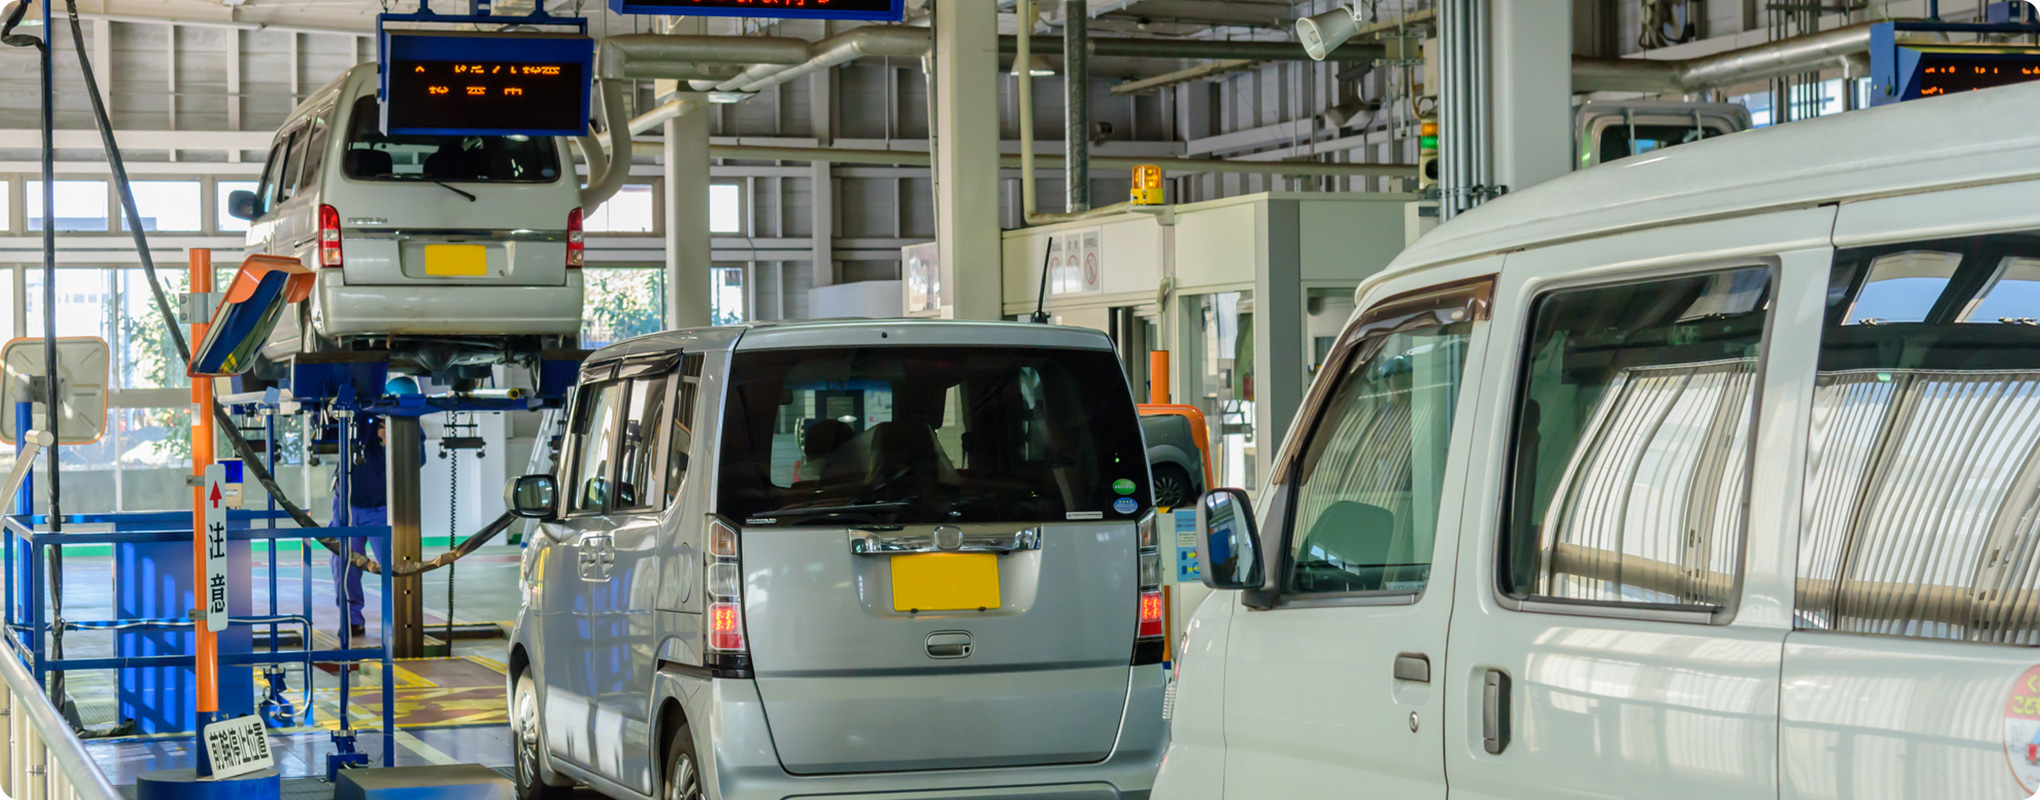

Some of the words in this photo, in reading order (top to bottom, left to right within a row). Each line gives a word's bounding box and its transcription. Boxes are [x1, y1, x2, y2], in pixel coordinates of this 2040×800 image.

[208, 521, 226, 614] 注意
[209, 722, 269, 771] 前輪停止位置
